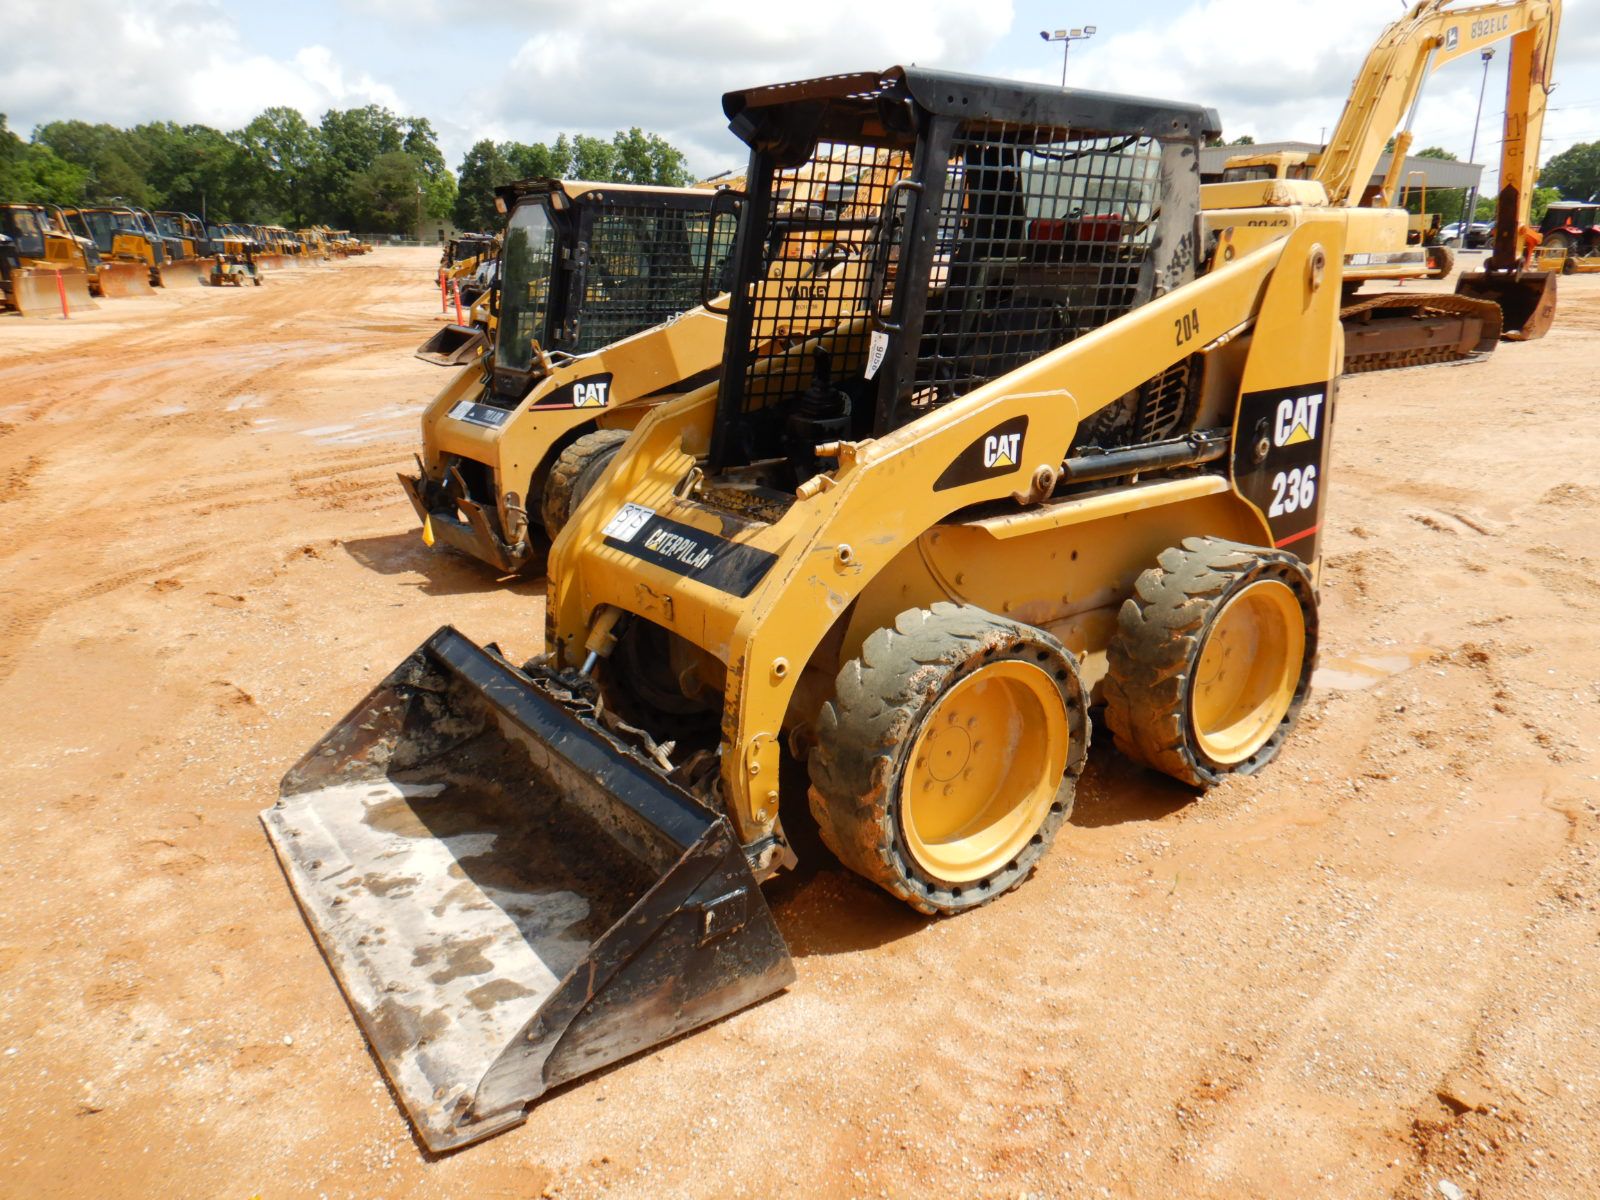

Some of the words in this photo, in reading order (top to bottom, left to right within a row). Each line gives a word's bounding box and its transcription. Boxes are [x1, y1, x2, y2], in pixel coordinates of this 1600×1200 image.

[1175, 307, 1199, 346] 204
[573, 382, 608, 407] CAT
[1274, 393, 1323, 447] CAT
[984, 433, 1021, 468] CAT
[1268, 464, 1316, 518] 236
